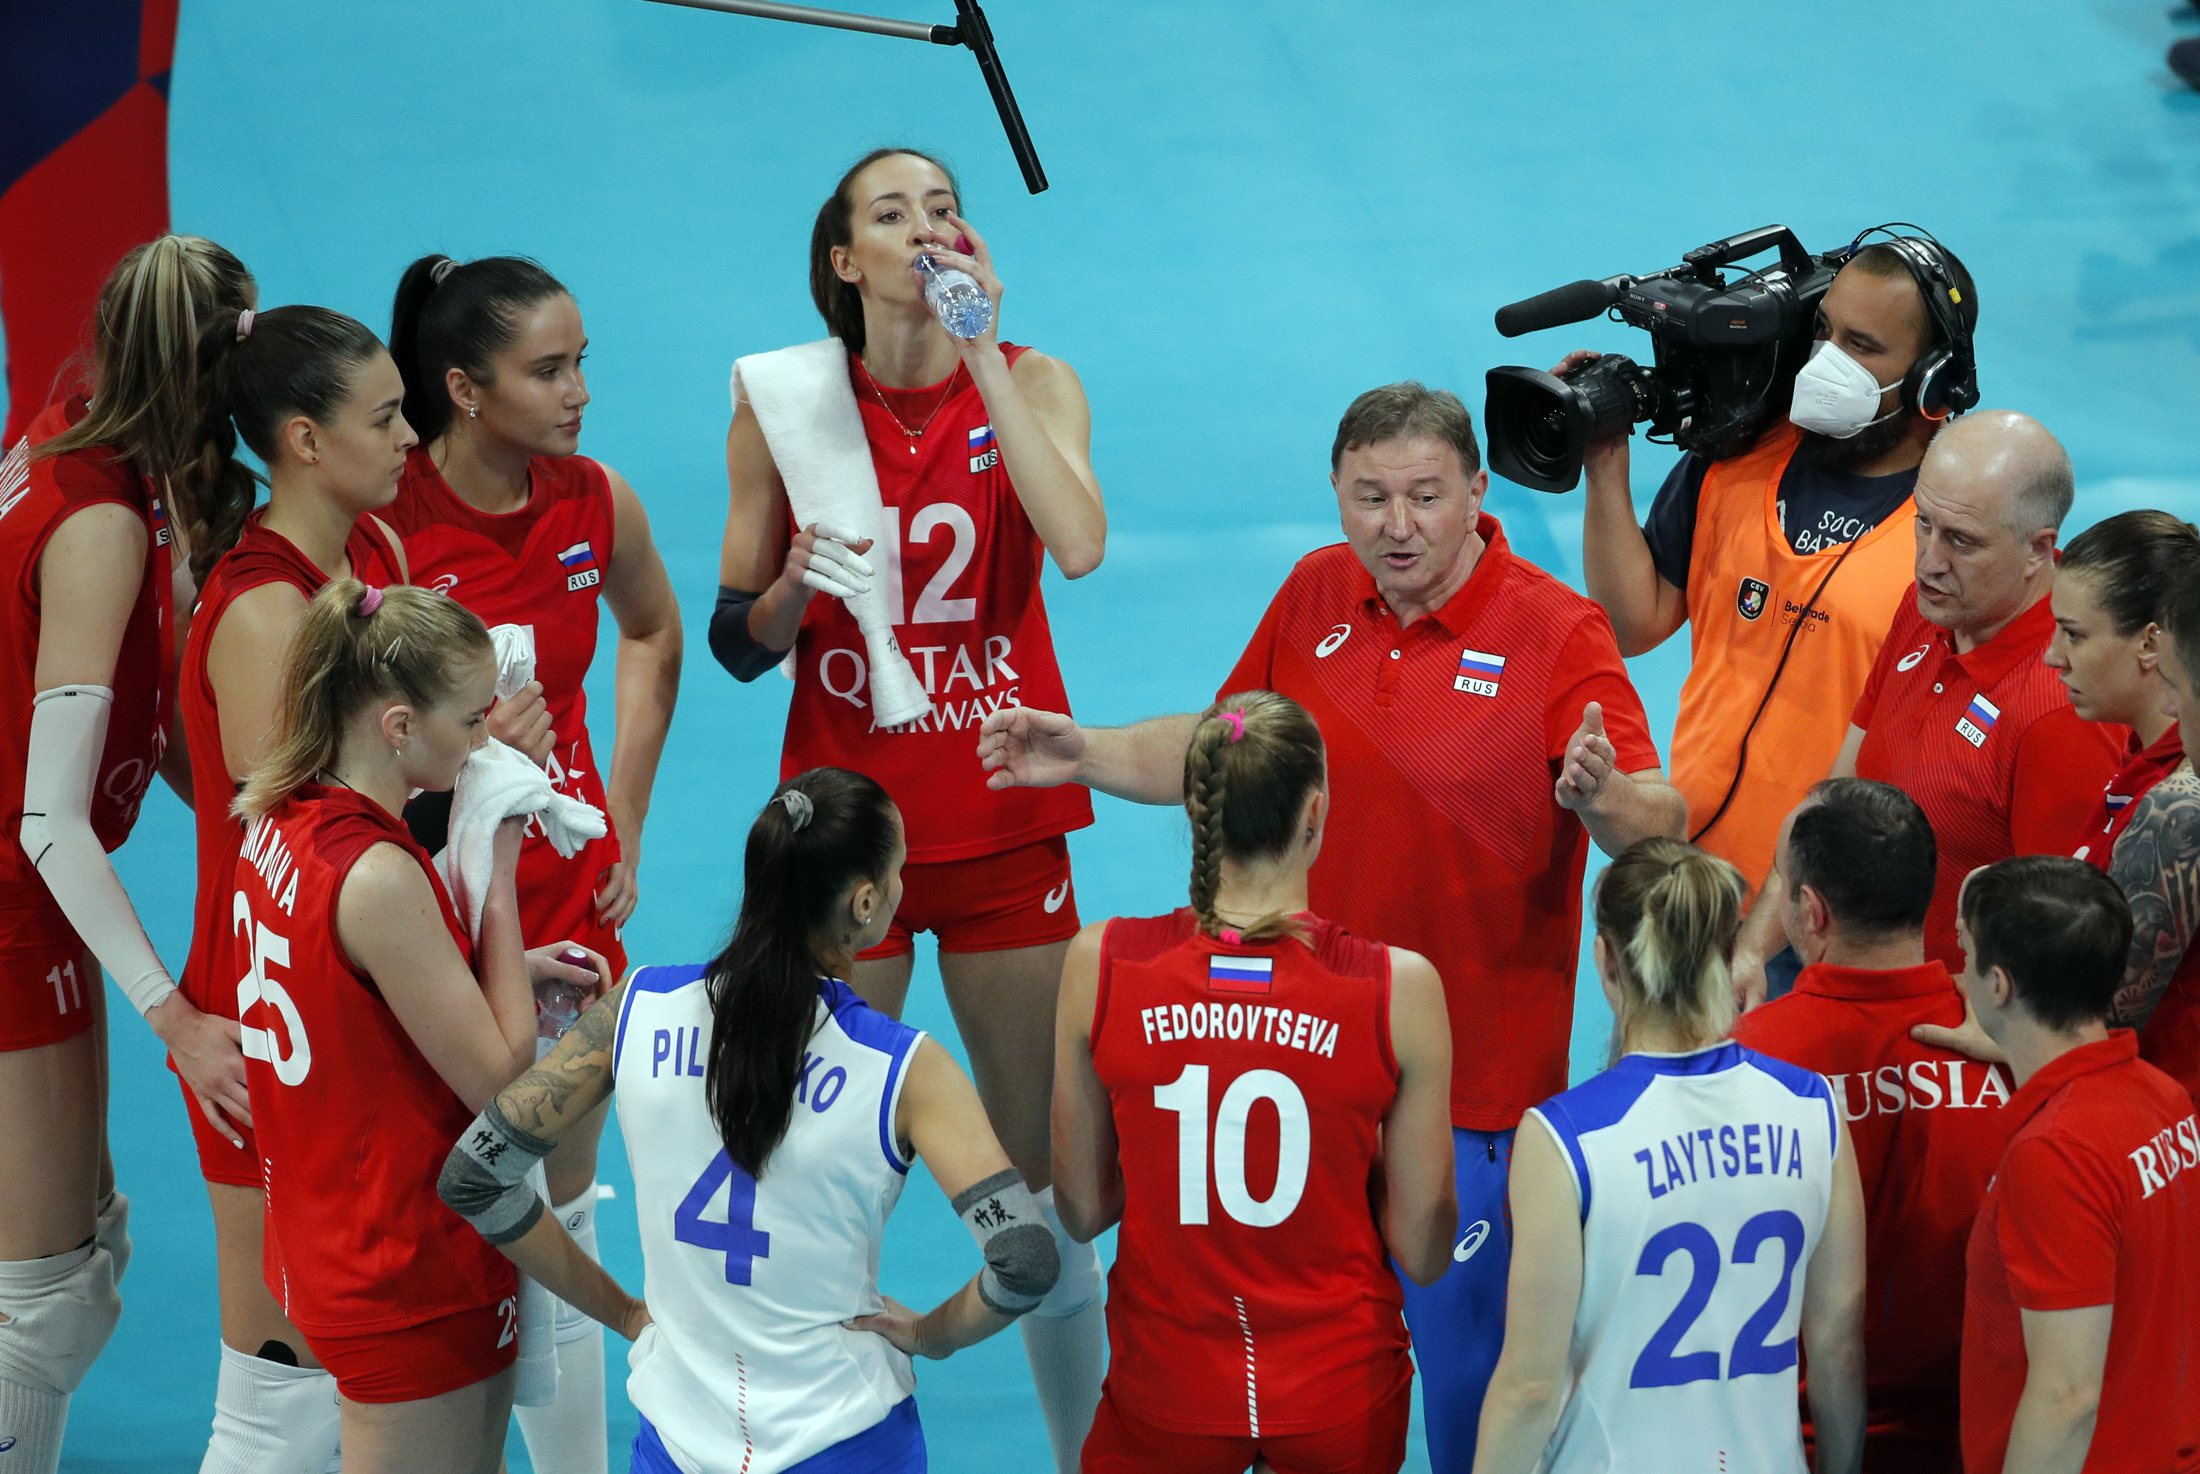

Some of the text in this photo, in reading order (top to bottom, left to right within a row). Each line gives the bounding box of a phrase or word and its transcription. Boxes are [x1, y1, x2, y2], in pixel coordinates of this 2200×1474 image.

[1795, 529, 1846, 554] BAT
[571, 571, 597, 589] RUS
[1750, 581, 1765, 592] CEV
[1784, 600, 1830, 623] Belrade
[819, 635, 1020, 709] QTAR
[1461, 679, 1493, 695] RUS
[1960, 722, 1982, 744] RUS
[46, 959, 82, 1015] 11
[233, 890, 312, 1087] 25
[1141, 1001, 1340, 1059] FEDOROVTSEVA
[1828, 1060, 2012, 1121] USSIA
[1153, 1063, 1311, 1228] 10
[1633, 1123, 1803, 1200] ZAYTSEVA
[674, 1145, 770, 1287] 4
[496, 1294, 518, 1350] 2
[1629, 1209, 1805, 1389] 22
